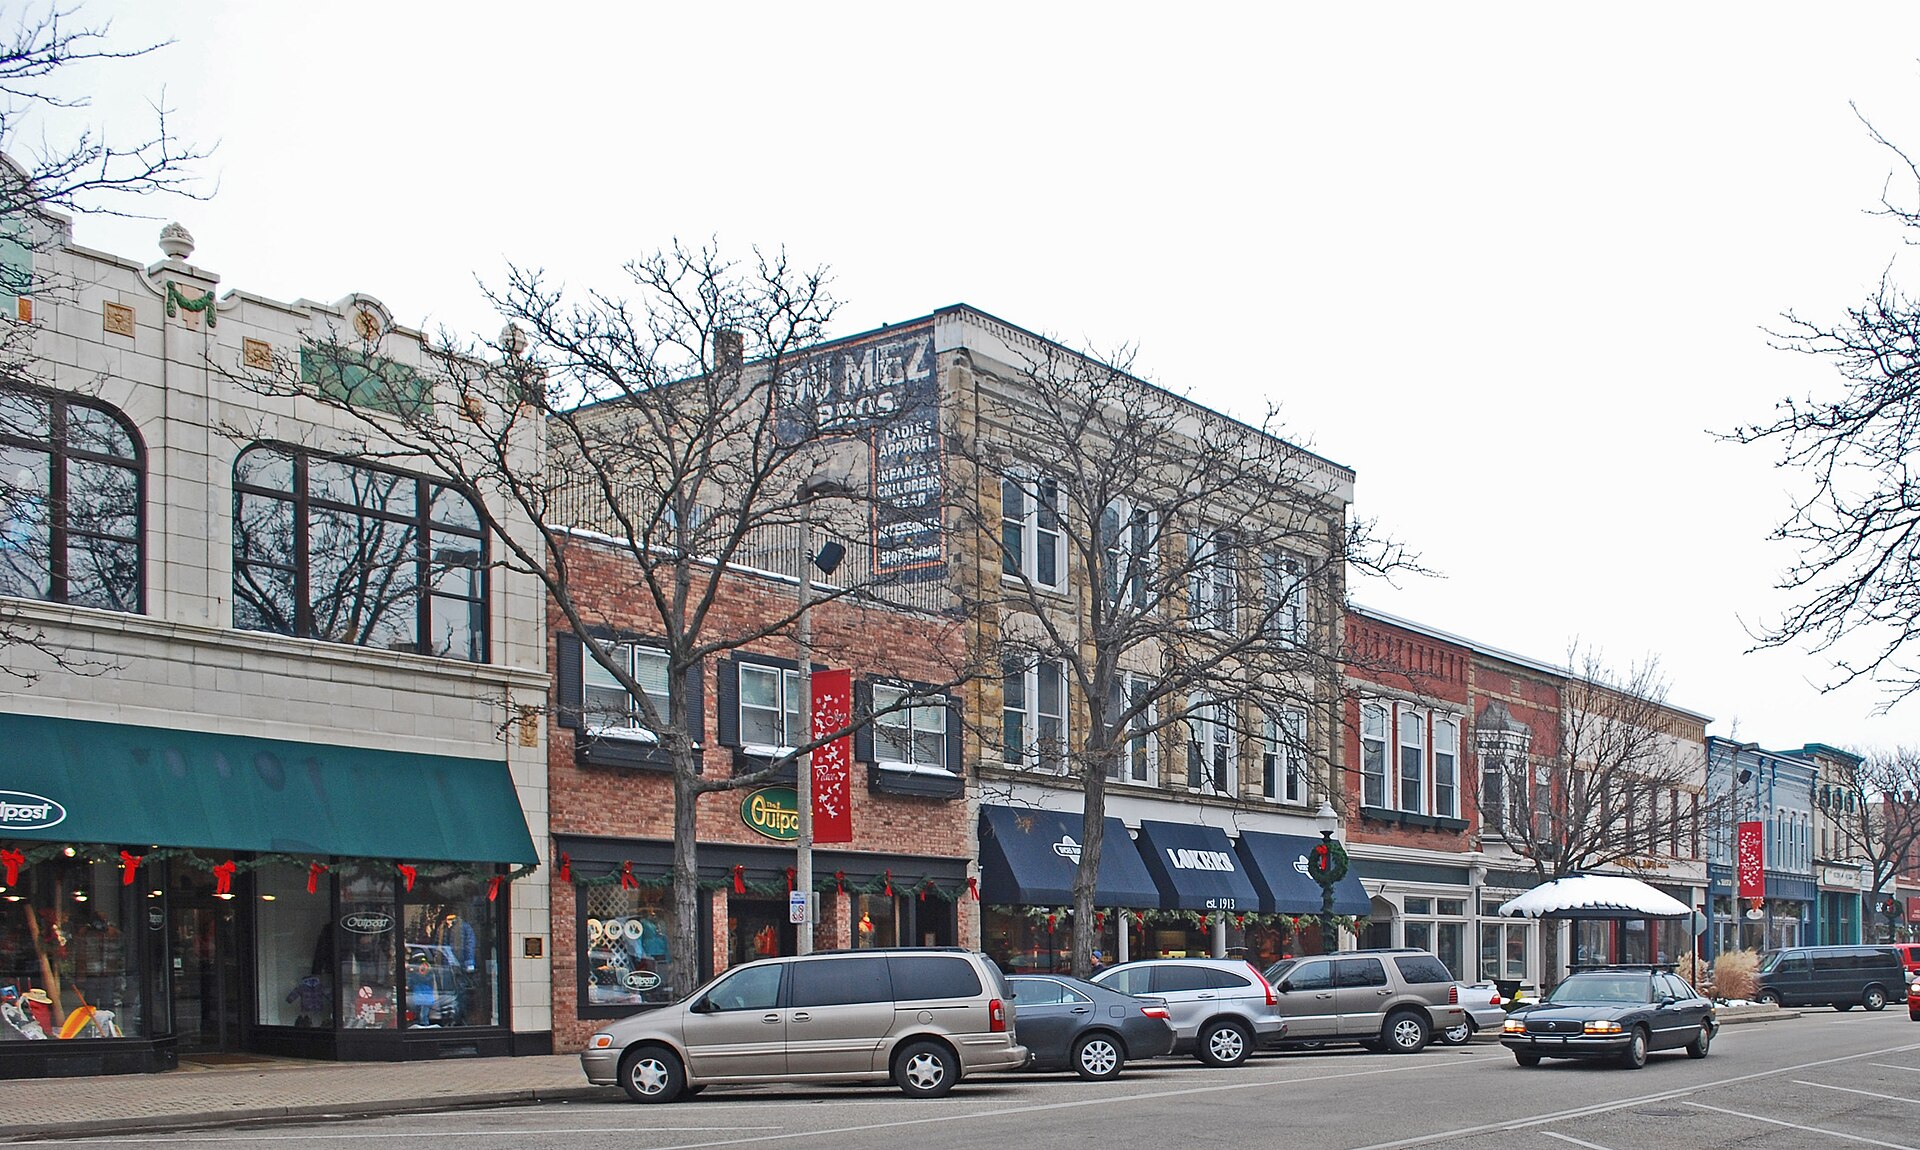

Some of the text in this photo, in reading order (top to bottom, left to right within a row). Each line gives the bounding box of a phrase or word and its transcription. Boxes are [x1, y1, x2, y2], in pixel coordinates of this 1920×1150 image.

[885, 420, 932, 442] LADIES
[878, 434, 936, 458] APPAREL
[751, 794, 799, 835] Outpo
[1166, 848, 1235, 872] LOKERS
[1219, 898, 1235, 910] 1913
[347, 916, 389, 930] Outpost
